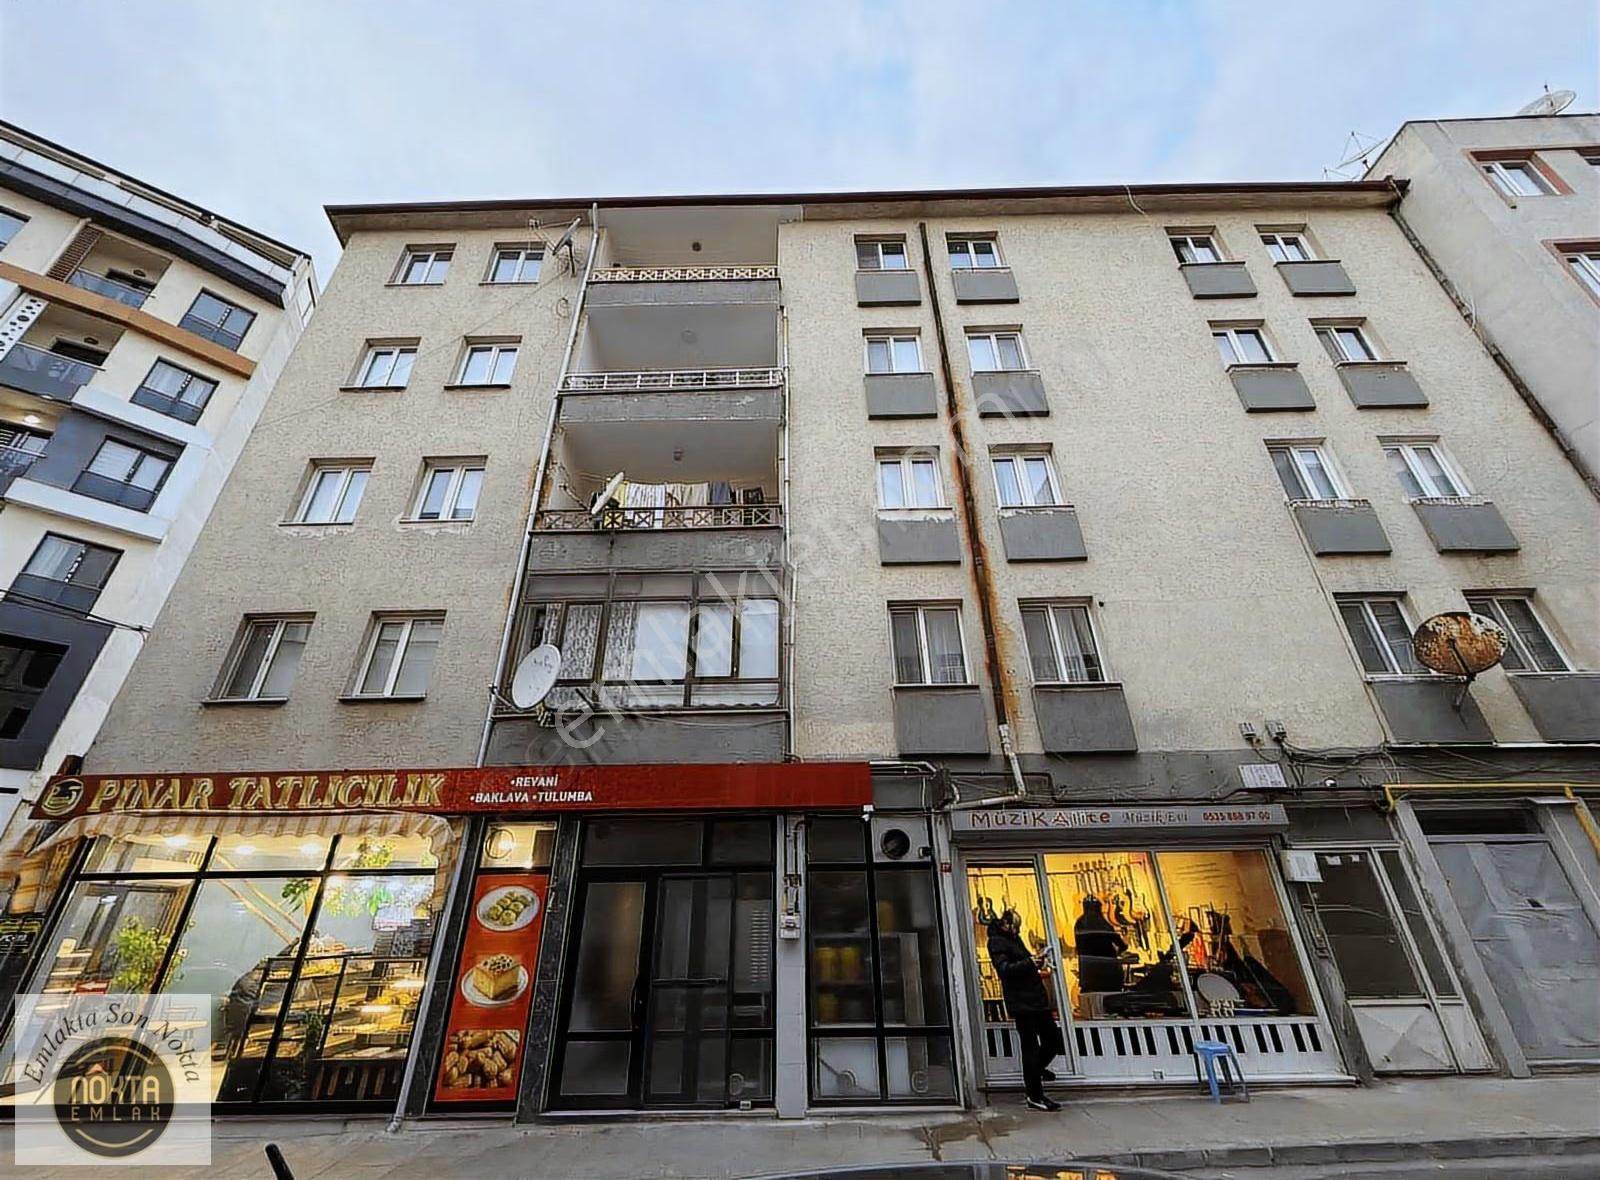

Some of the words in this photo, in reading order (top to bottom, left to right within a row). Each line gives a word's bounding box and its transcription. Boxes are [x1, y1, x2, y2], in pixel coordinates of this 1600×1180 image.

[87, 775, 215, 812] PINAR
[227, 773, 446, 810] TATLICILIK
[474, 791, 529, 804] BAKLAVA
[537, 791, 593, 803] TULUMBA
